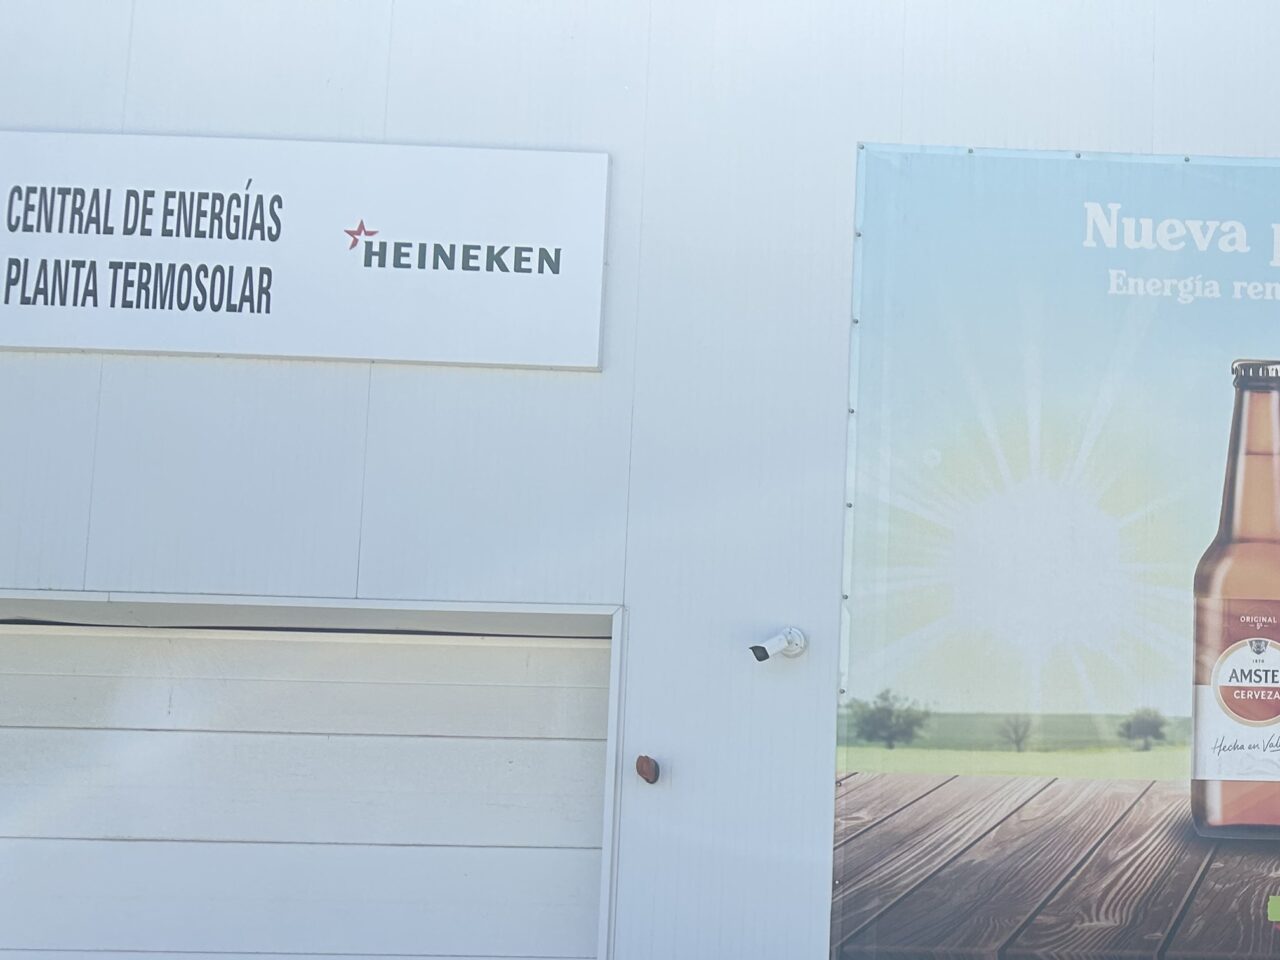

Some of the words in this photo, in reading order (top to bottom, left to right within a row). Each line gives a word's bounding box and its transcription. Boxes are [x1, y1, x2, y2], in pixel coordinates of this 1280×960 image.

[6, 185, 115, 236] CENTRAL
[122, 189, 155, 237] DE
[161, 178, 283, 242] ENERGÍAS
[1083, 201, 1250, 252] Nueva
[363, 240, 562, 275] HEINEKEN
[4, 257, 99, 307] PLANTA
[109, 260, 273, 314] TERMOSOLAR
[1108, 269, 1221, 304] Energía
[1240, 616, 1277, 624] ORIGINAL
[1233, 690, 1280, 700] CERVEZA
